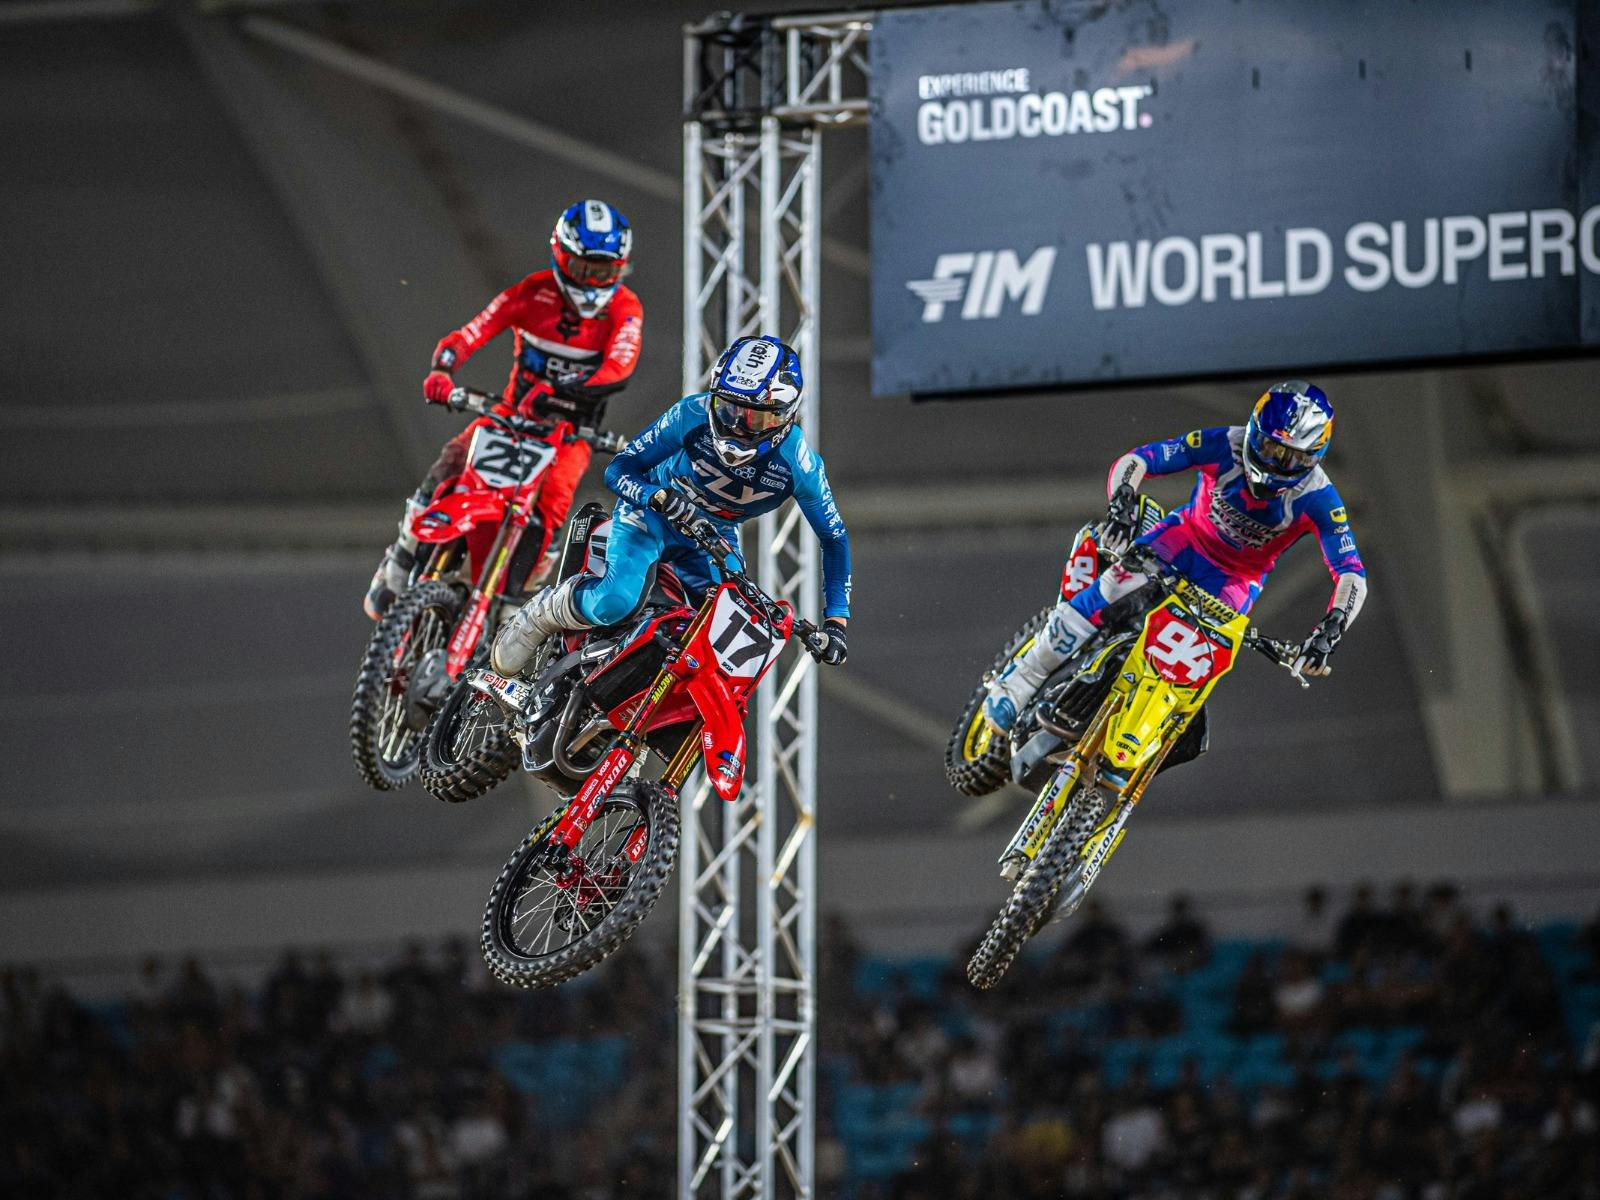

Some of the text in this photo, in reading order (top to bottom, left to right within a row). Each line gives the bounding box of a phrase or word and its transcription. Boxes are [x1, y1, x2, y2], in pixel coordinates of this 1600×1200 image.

[918, 67, 1030, 100] EXPERIENCE
[906, 246, 1057, 323] FIM
[1086, 228, 1333, 310] WORLD
[717, 389, 752, 402] HONDA
[712, 609, 775, 669] 17
[1145, 620, 1219, 682] 94
[585, 753, 628, 819] DUNLOP
[1020, 785, 1062, 848] DUNLOP
